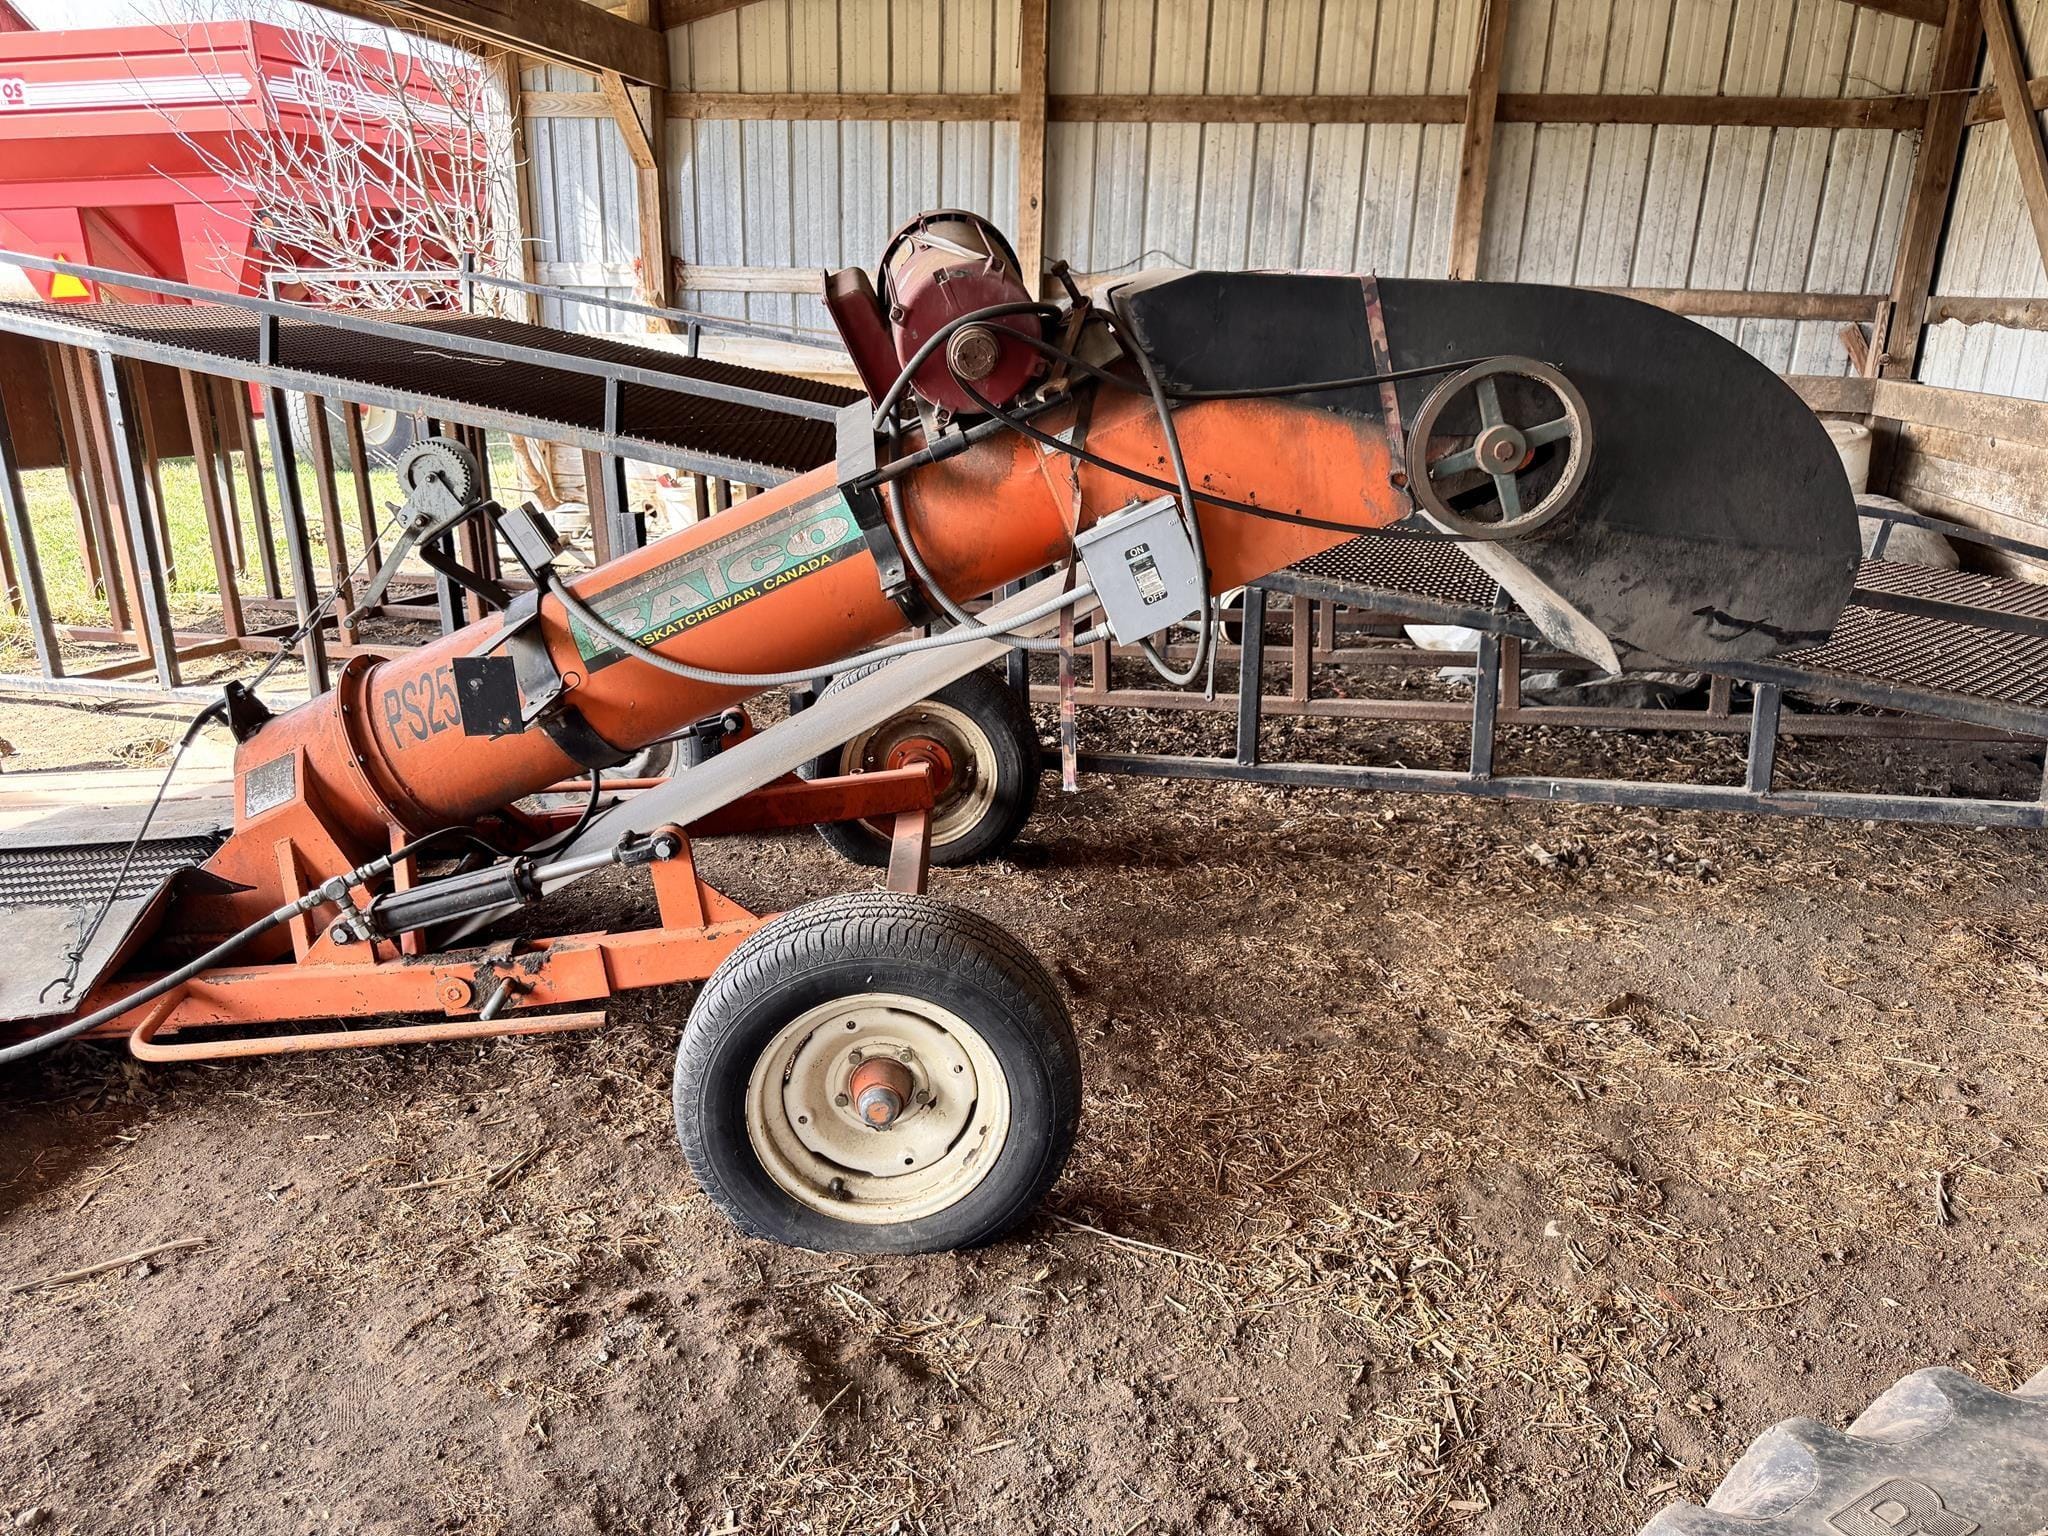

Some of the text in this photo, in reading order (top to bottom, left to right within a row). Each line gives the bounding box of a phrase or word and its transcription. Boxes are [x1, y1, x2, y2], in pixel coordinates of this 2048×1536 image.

[643, 519, 769, 580] SWIFT CURRENT
[1129, 545, 1145, 557] ON
[615, 554, 833, 657] ASKATCHEWAN, CANADA
[1146, 591, 1166, 604] OFF
